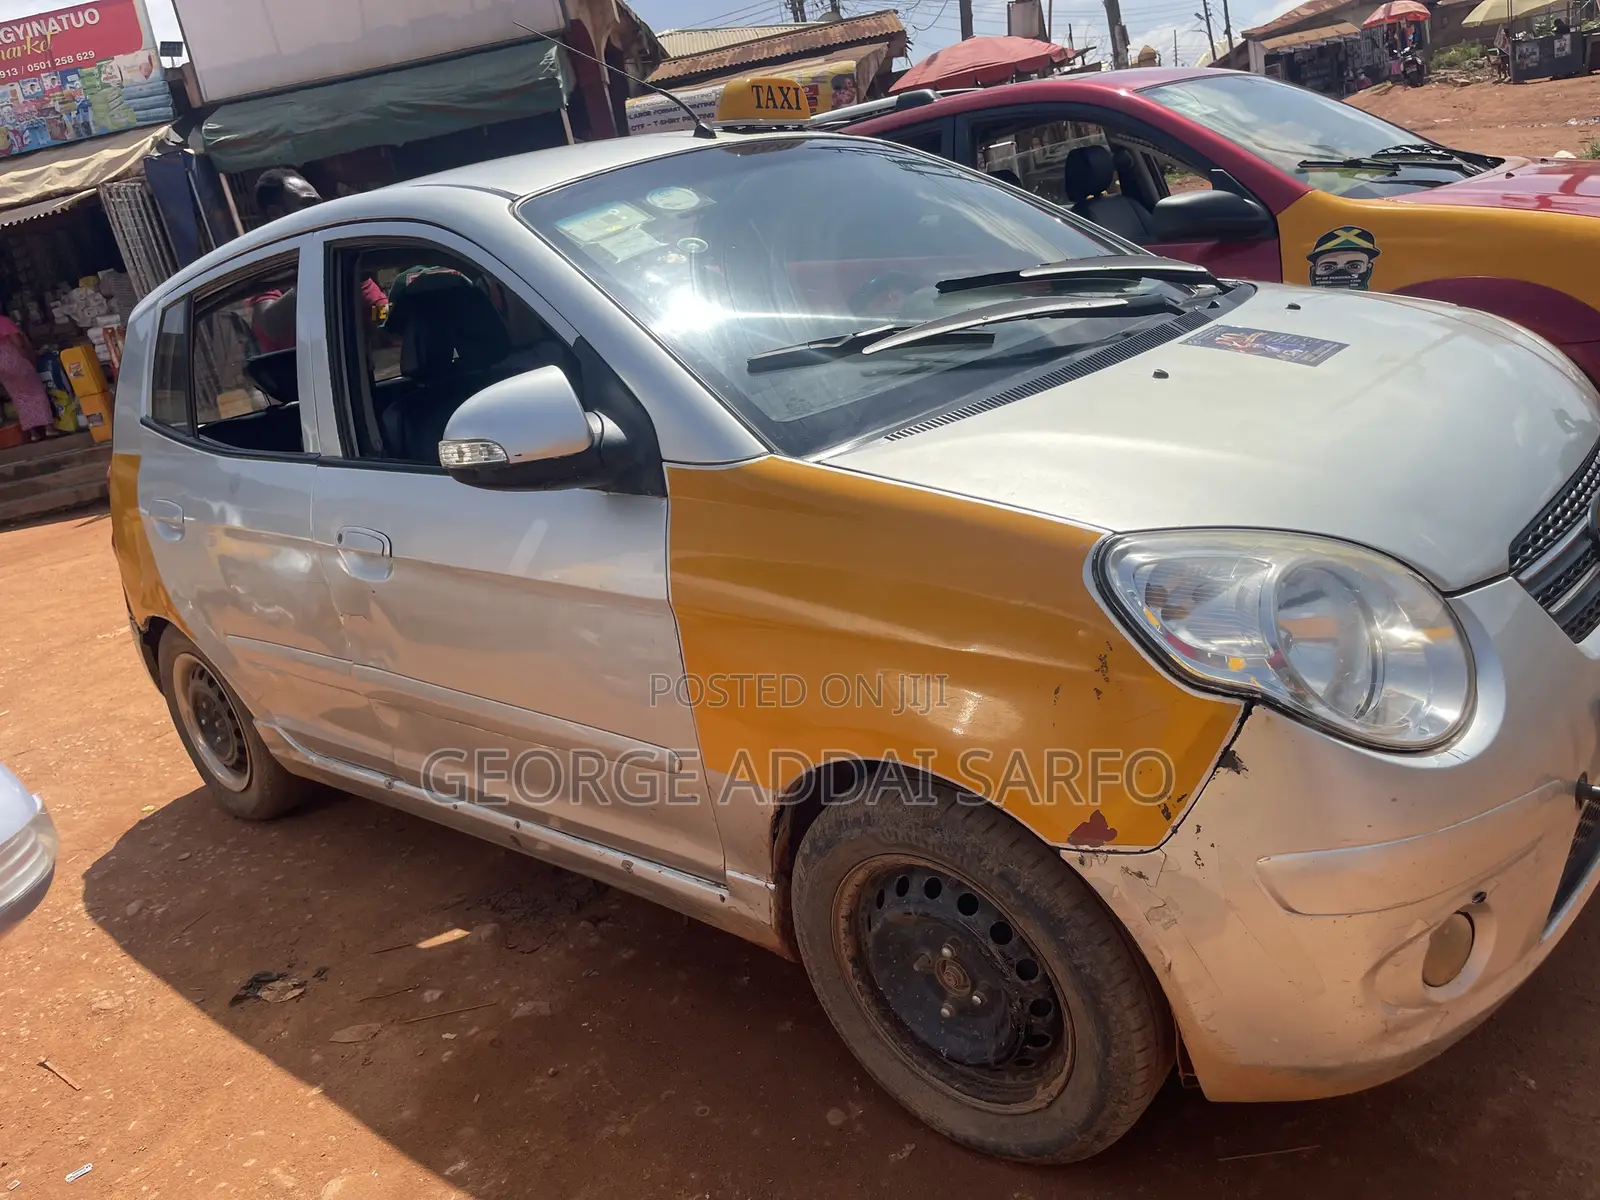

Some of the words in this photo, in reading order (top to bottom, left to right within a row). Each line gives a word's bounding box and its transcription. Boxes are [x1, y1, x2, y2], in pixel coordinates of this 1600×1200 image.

[0, 8, 100, 45] GYINATUO
[27, 60, 52, 72] 0501
[54, 55, 74, 66] 258
[76, 50, 95, 61] 629
[751, 85, 802, 110] TAXI
[628, 110, 651, 119] LARGE
[653, 106, 681, 115] FORMAT
